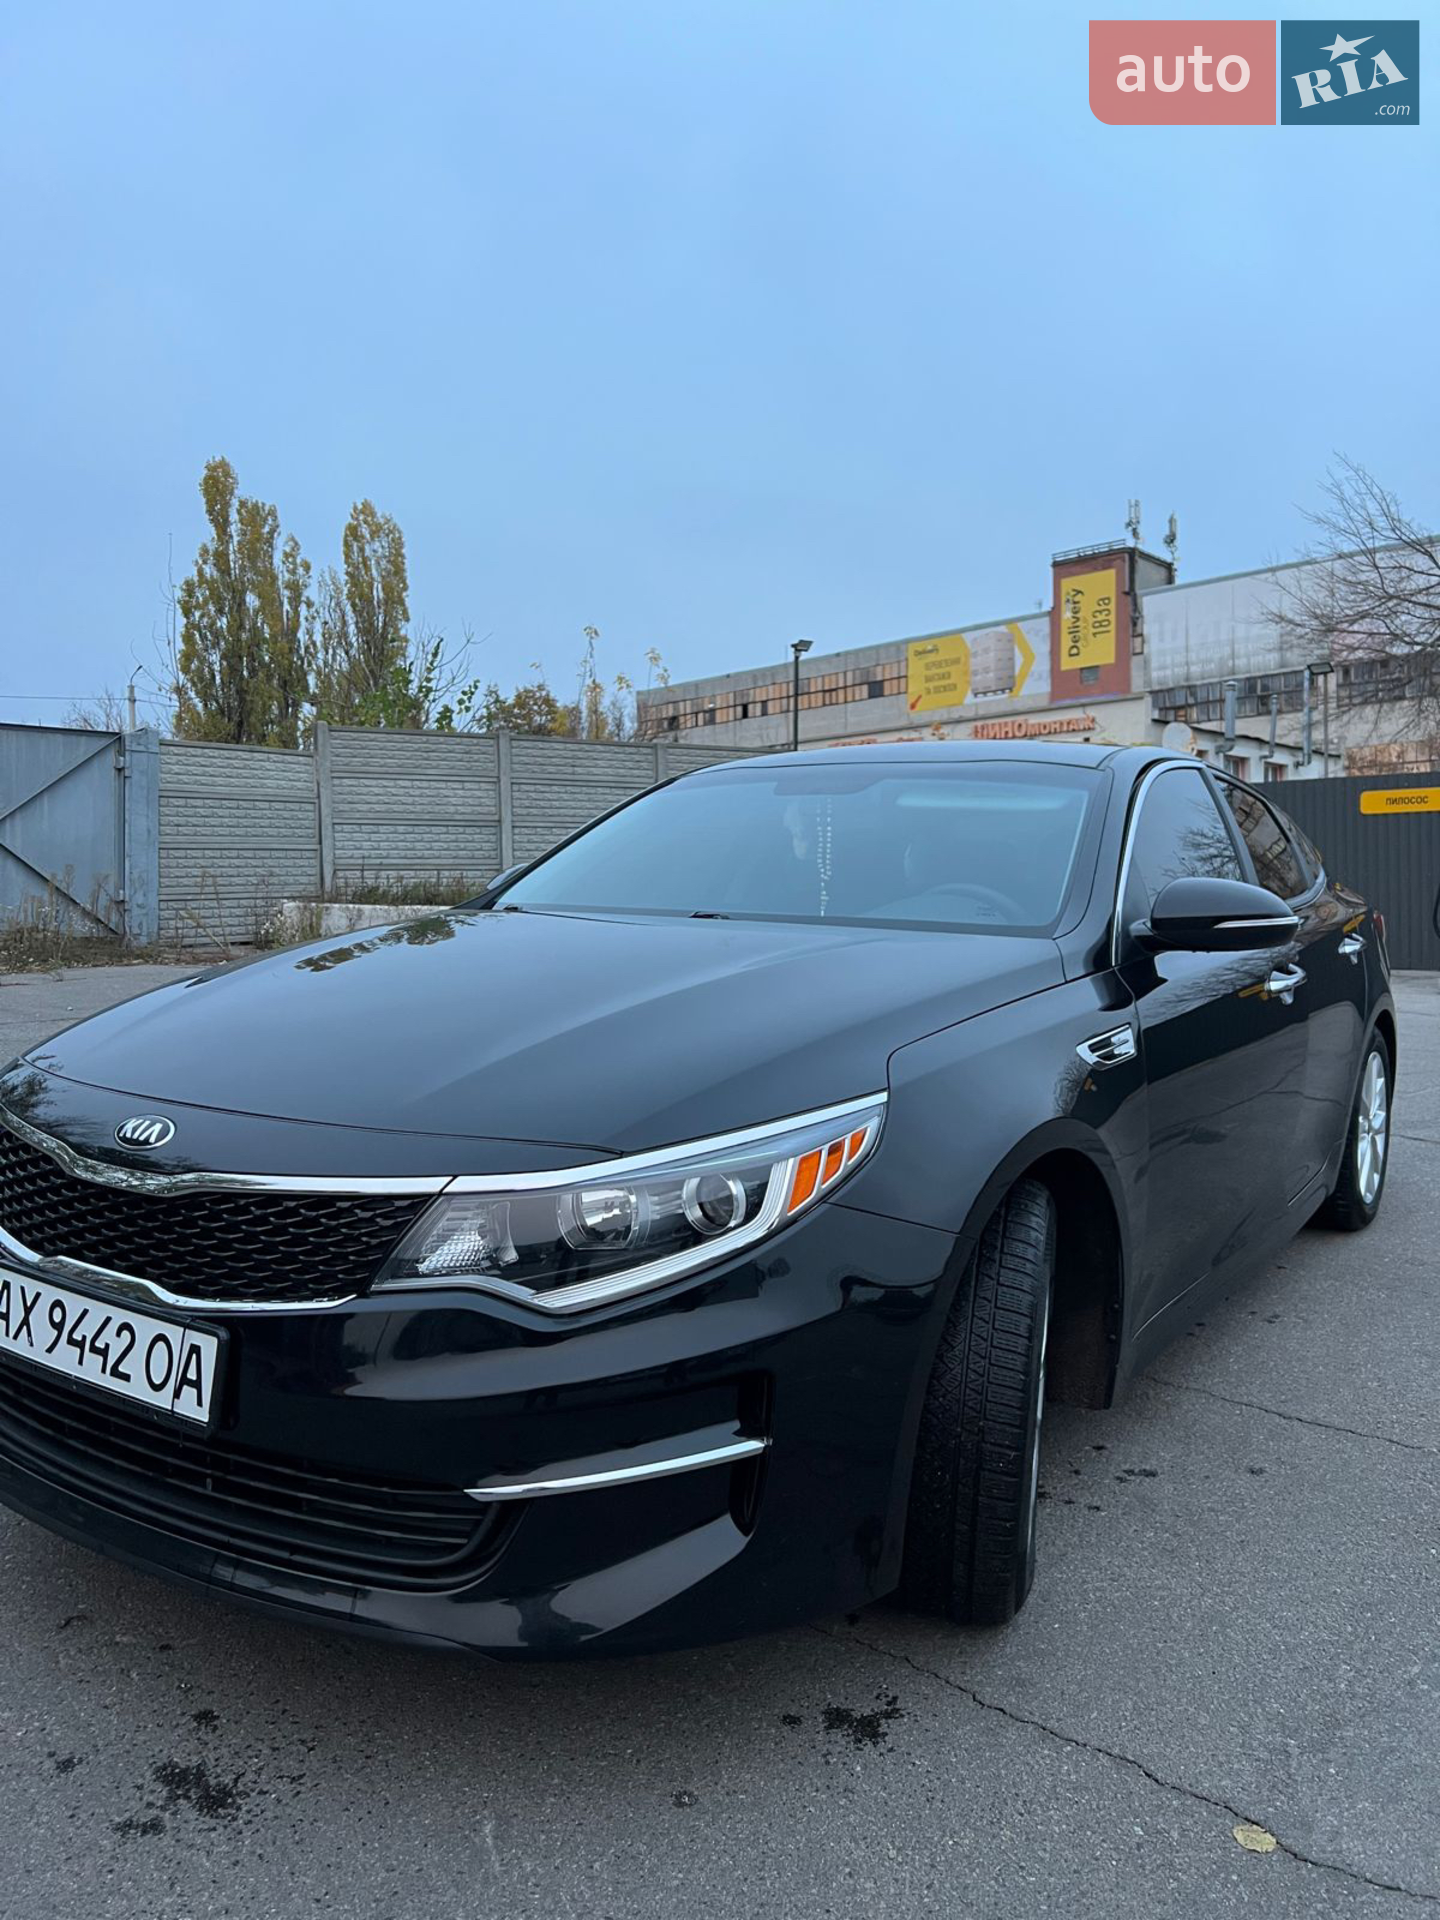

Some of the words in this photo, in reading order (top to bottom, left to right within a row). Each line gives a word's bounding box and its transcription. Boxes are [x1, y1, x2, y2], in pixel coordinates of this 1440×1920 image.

[1067, 588, 1085, 658] Delivery
[119, 1118, 163, 1144] KIA
[0, 1280, 42, 1347] AX
[45, 1298, 136, 1383] 9442
[145, 1333, 203, 1408] OA
